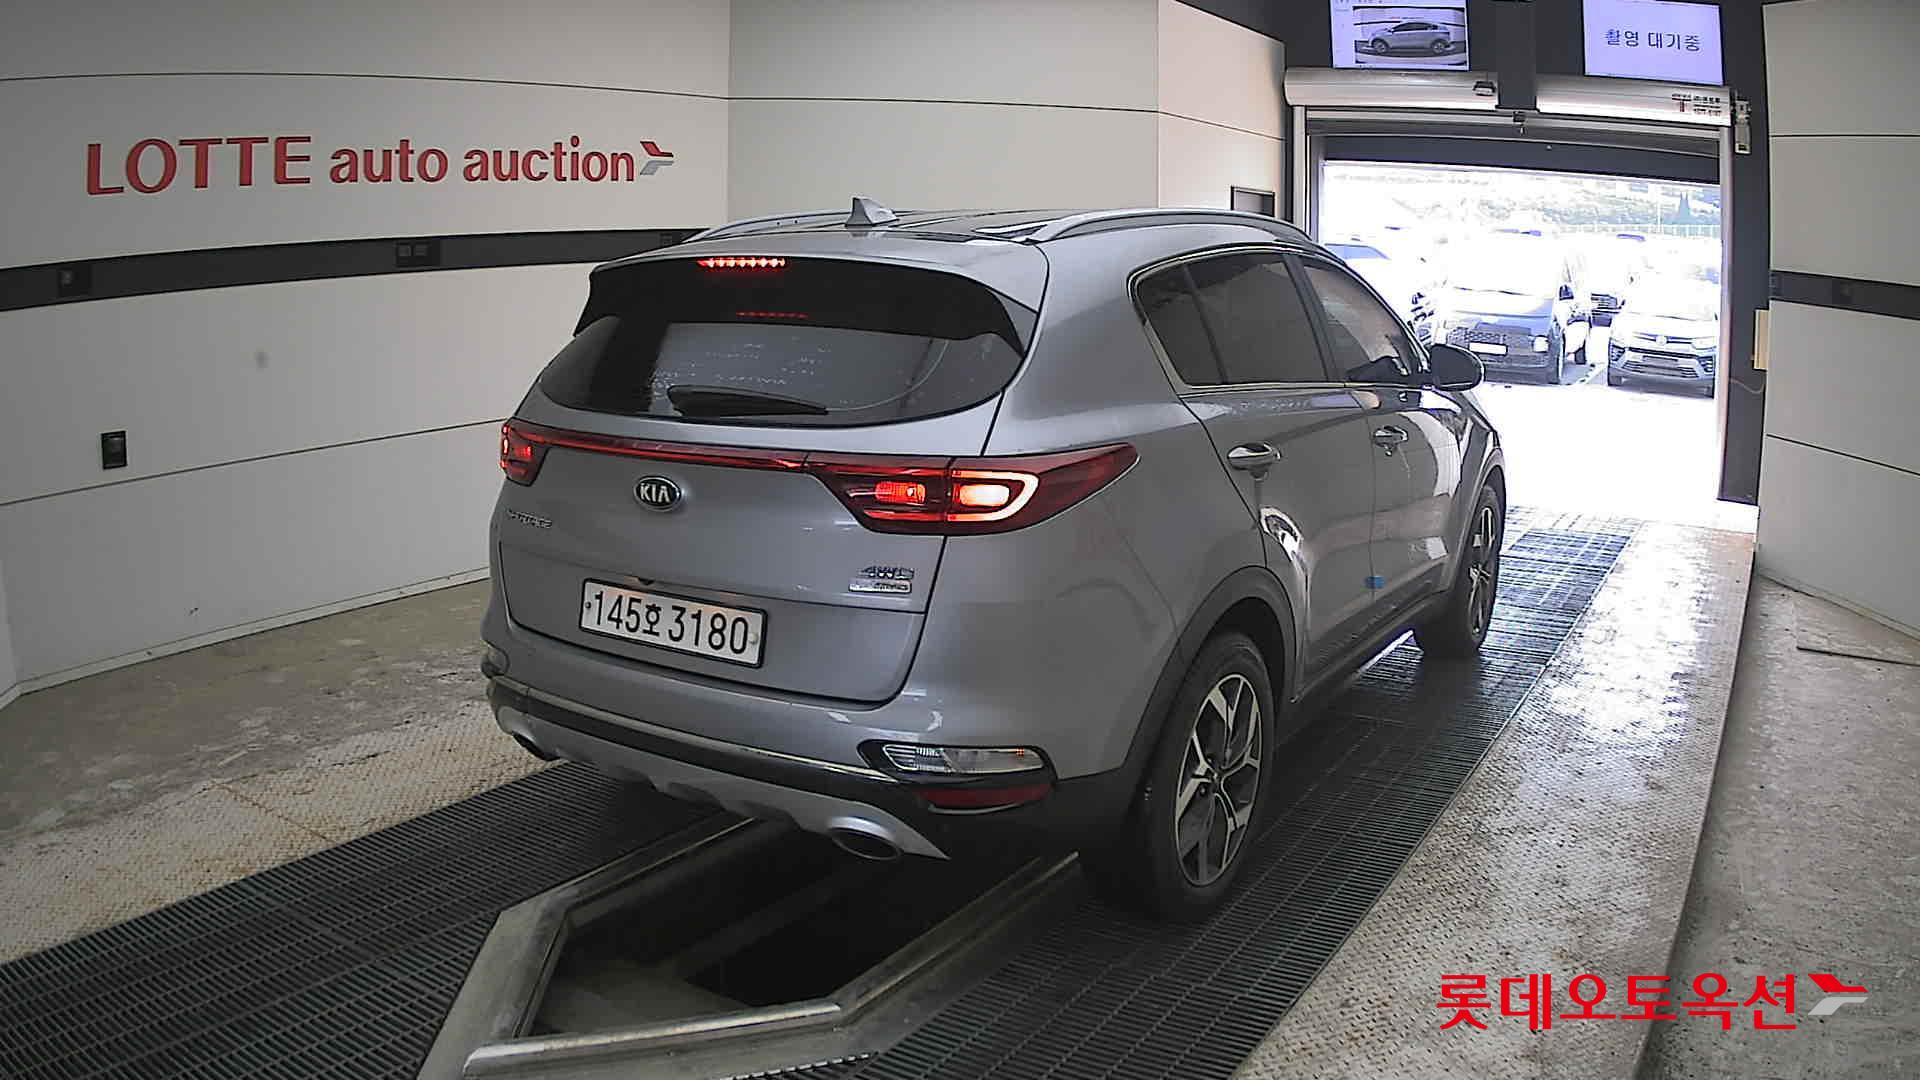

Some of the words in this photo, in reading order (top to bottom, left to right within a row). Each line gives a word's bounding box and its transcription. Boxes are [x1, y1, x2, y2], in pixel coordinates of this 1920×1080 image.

[1606, 29, 1640, 48] 촬영
[1647, 32, 1701, 52] 대기중
[87, 136, 312, 196] LOTTE
[329, 139, 449, 184] auto
[463, 135, 636, 183] auction
[639, 482, 671, 503] KIA
